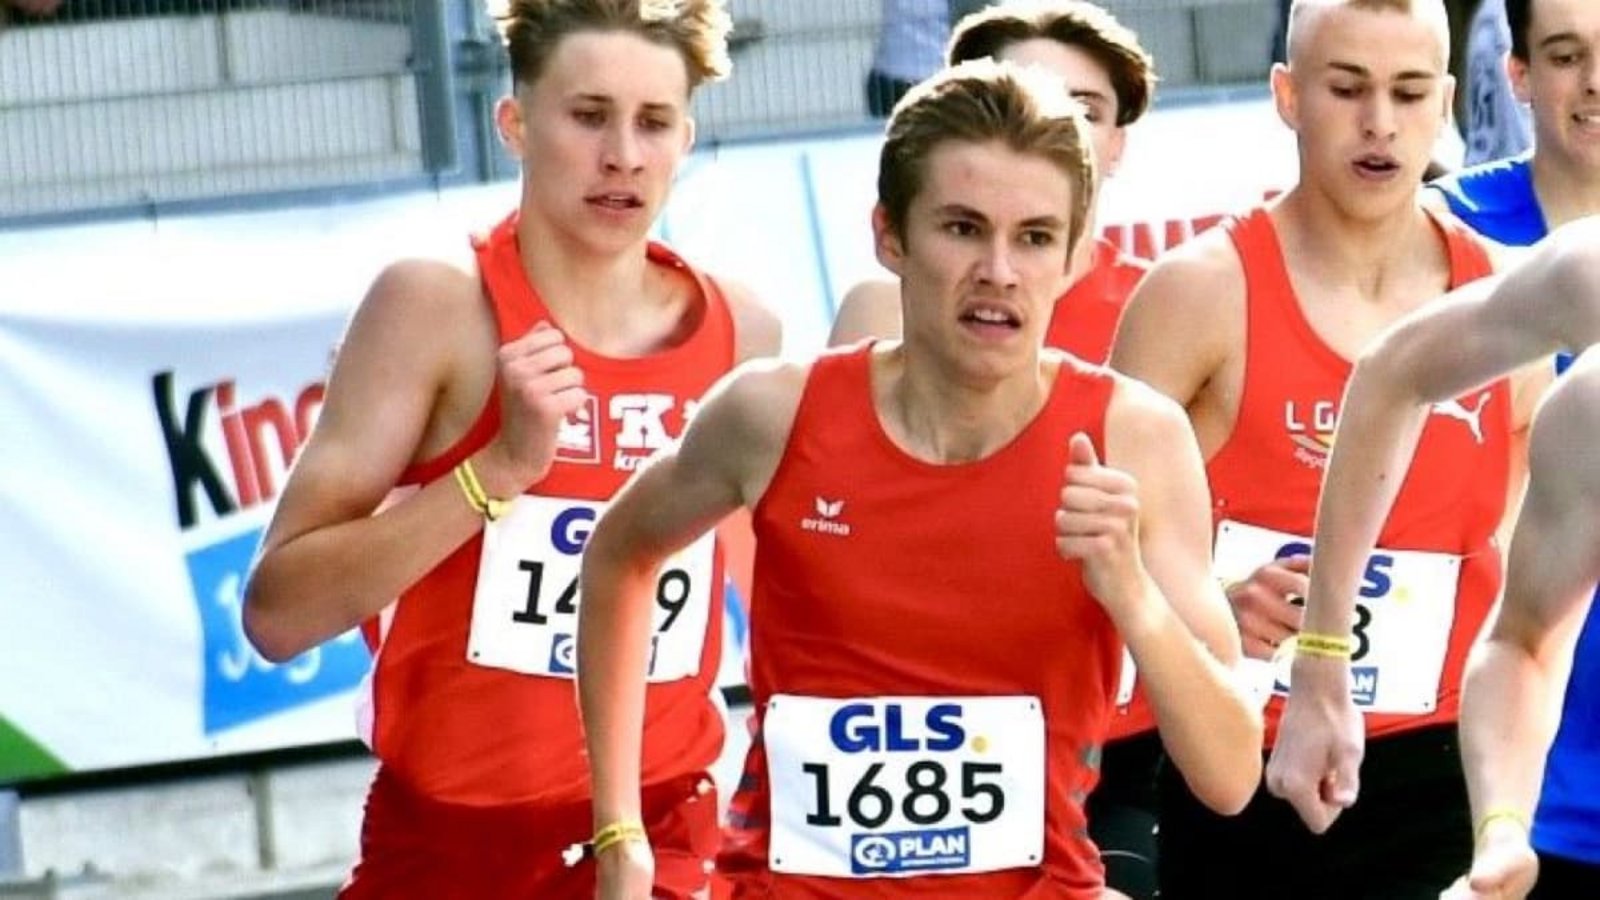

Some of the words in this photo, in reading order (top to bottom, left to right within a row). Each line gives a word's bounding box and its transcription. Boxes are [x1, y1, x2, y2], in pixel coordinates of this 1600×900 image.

[801, 518, 851, 536] erima
[802, 760, 1006, 829] 1685
[900, 834, 966, 859] PLAN
